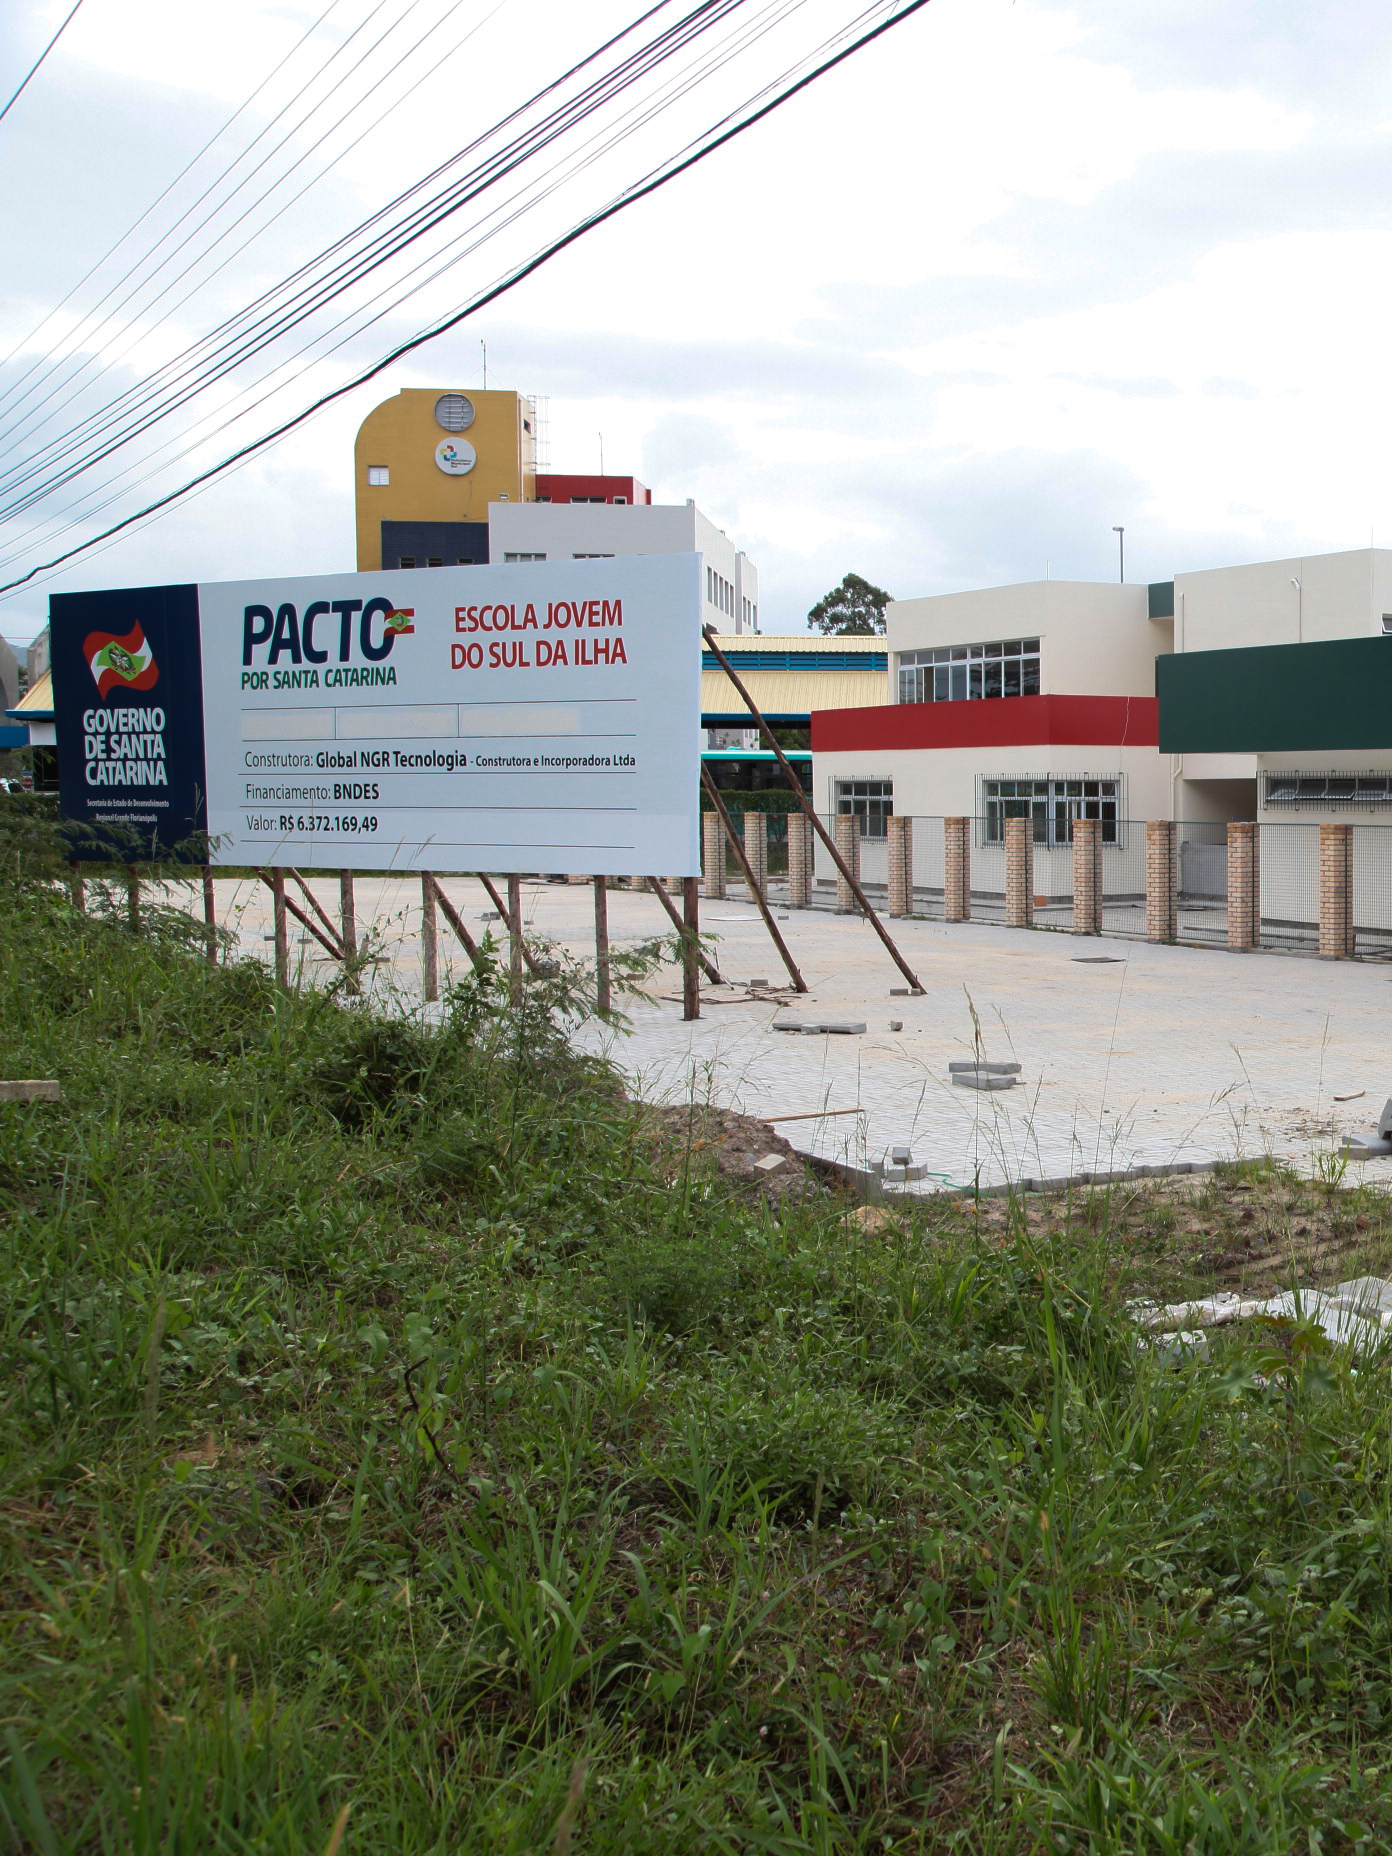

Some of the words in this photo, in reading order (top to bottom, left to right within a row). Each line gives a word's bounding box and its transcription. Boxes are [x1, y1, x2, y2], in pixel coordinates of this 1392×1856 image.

[455, 604, 538, 632] ESCOLA
[543, 599, 622, 629] JOVEM
[243, 597, 395, 666] PACTO
[451, 643, 484, 670] DO
[489, 641, 530, 668] SUL
[536, 640, 568, 667] DA
[574, 638, 627, 665] ILHA
[242, 671, 269, 690] POR
[273, 669, 320, 689] SANTA
[325, 667, 397, 687] CATARINA
[83, 707, 166, 733] GOVERNO
[84, 734, 107, 759] DE
[110, 734, 166, 759] SANTA
[245, 752, 313, 767] Construtora:
[316, 751, 357, 768] Global
[361, 751, 390, 767] NGR
[393, 750, 467, 771] Tecnologia
[476, 756, 531, 767] Construtora
[533, 758, 539, 767] e
[541, 754, 610, 769] Incorporadora
[613, 754, 636, 766] Ltda
[85, 761, 168, 785] CATARINA
[246, 784, 331, 800] Financiamento:
[333, 783, 380, 800] BNDES
[246, 815, 277, 831] Valor:
[280, 814, 294, 831] R$
[297, 816, 378, 834] 6.372.169,49
